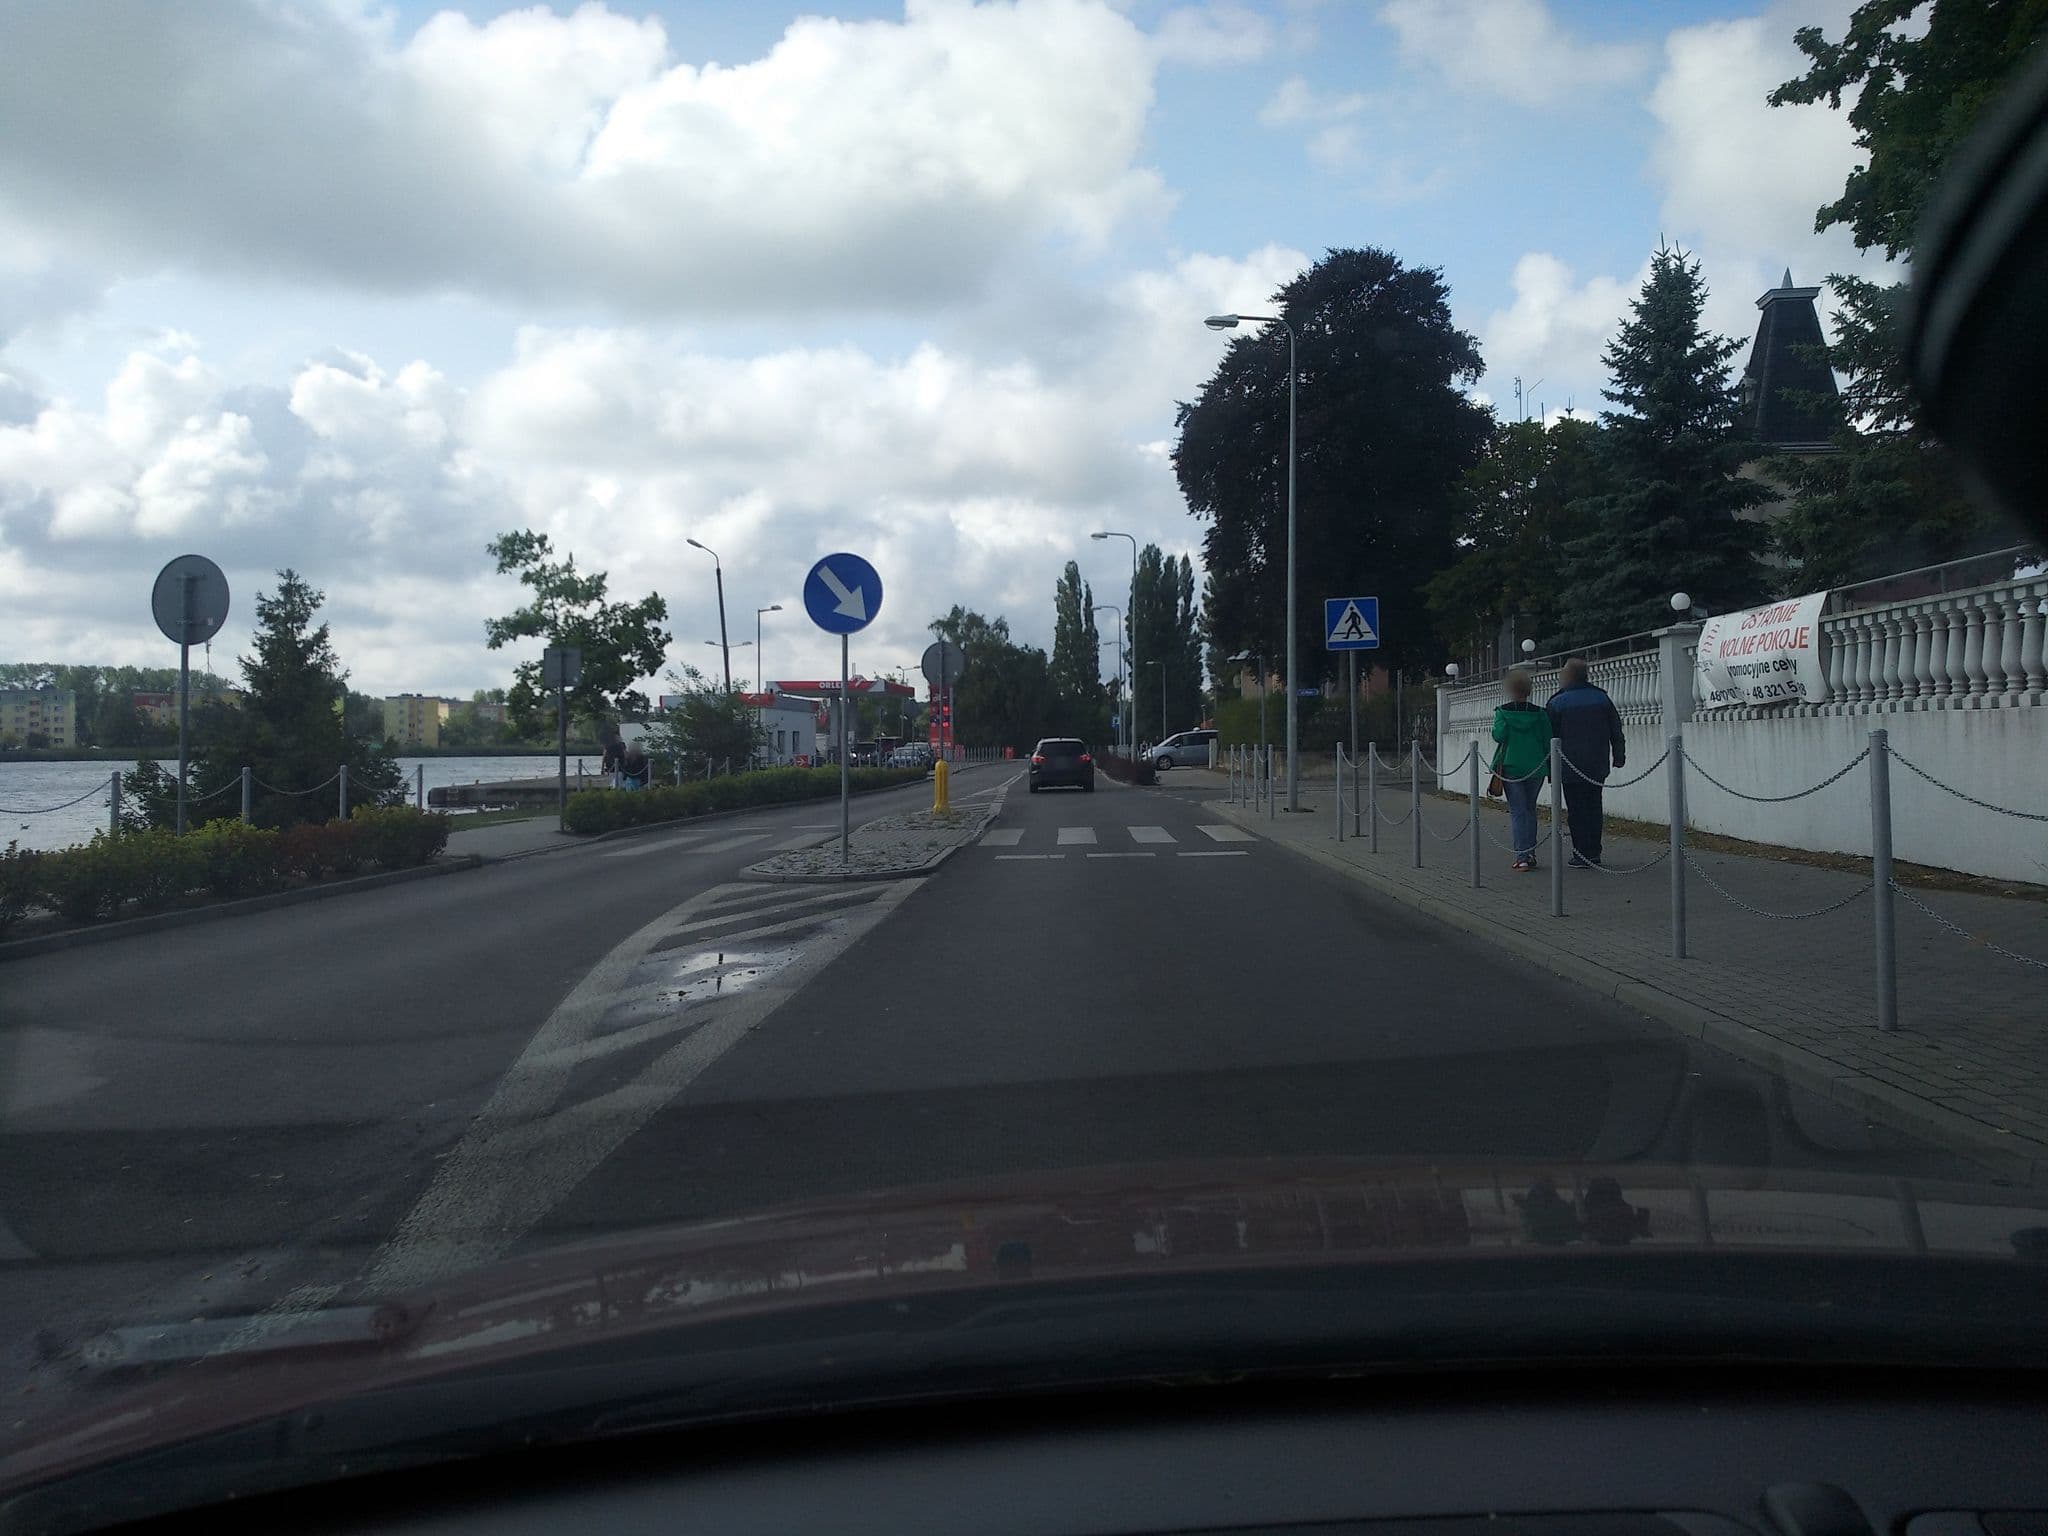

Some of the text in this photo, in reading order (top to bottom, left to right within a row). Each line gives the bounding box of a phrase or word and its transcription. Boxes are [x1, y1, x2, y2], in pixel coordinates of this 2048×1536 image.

[1719, 634, 1757, 659] WOLNE
[1756, 626, 1810, 653] POKOJE
[819, 681, 843, 689] ORLE
